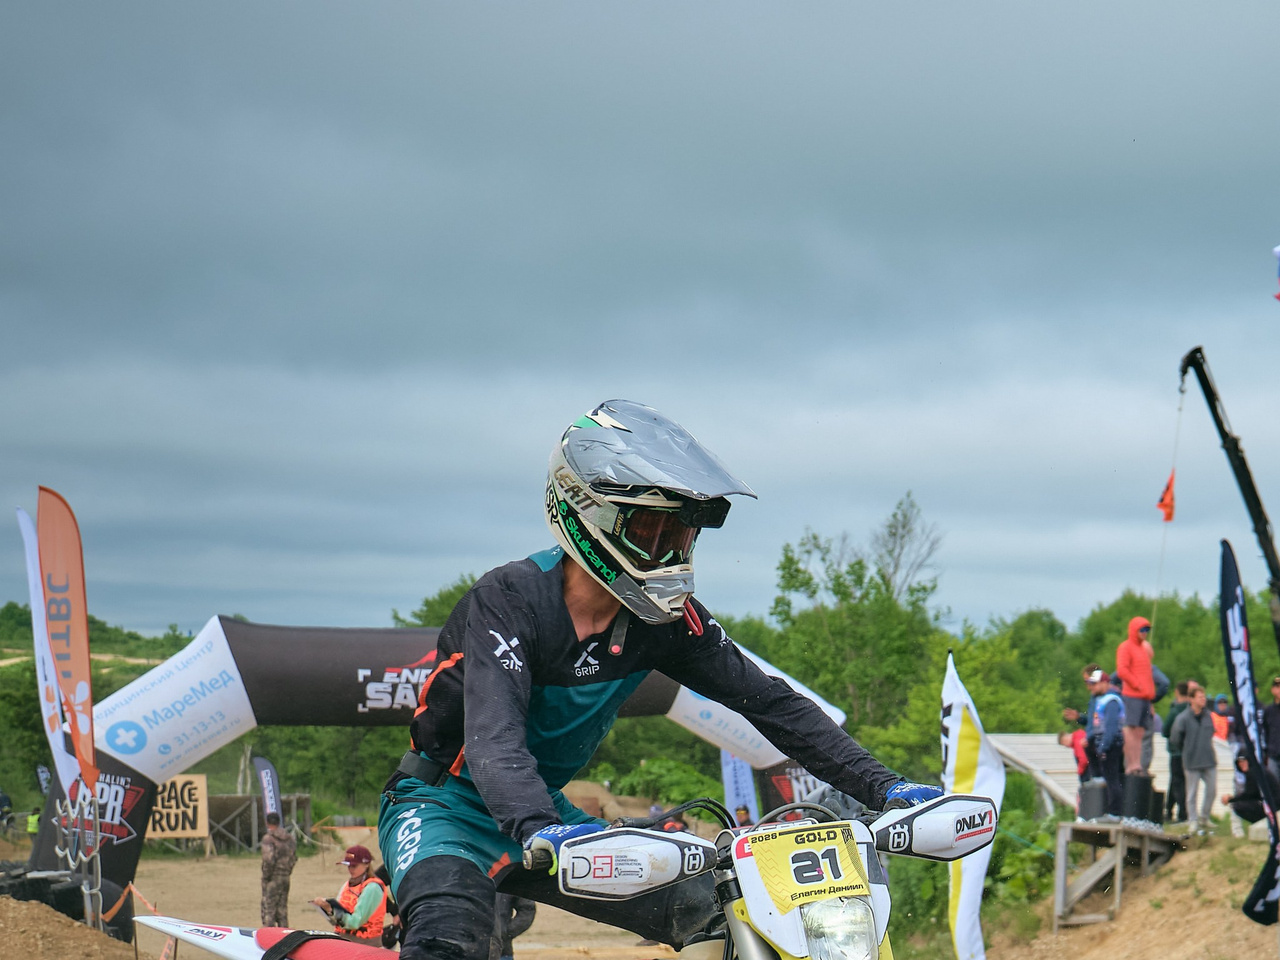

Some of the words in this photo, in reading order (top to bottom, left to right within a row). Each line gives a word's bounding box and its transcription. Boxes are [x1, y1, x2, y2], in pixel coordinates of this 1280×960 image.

[565, 516, 617, 584] Skullcandy
[574, 666, 600, 677] GRIP
[93, 671, 175, 720] едицинский
[142, 669, 236, 731] МареМед
[365, 681, 419, 709] SA
[174, 711, 227, 747] 31-13-13
[152, 805, 199, 832] RUN
[955, 810, 993, 834] ONLY1
[795, 830, 838, 844] GOLD
[790, 848, 843, 885] 21
[791, 888, 827, 902] Елагин
[827, 883, 865, 896] Даниил
